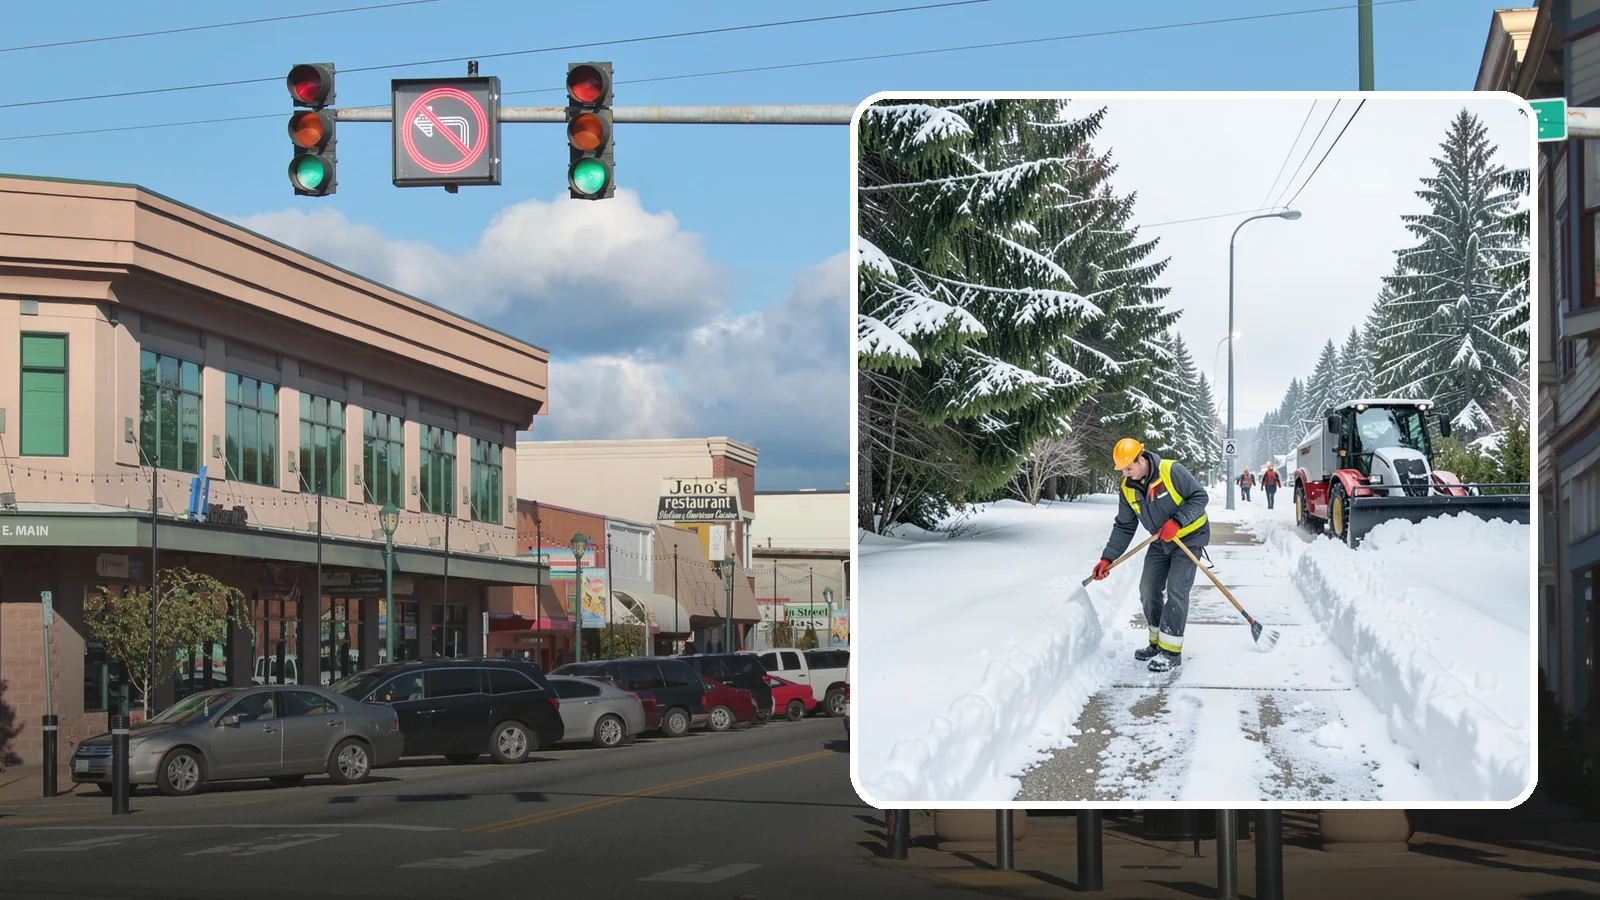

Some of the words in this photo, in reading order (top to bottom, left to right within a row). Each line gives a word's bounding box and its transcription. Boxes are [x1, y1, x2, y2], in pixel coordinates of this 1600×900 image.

[670, 480, 727, 494] Jeno's
[665, 496, 731, 509] restaurant
[659, 510, 681, 519] Italian
[686, 510, 715, 519] American
[715, 509, 737, 519] Cuisine
[2, 525, 13, 536] E.
[15, 525, 49, 536] MAIN
[797, 607, 828, 617] Street
[791, 619, 823, 627] lass
